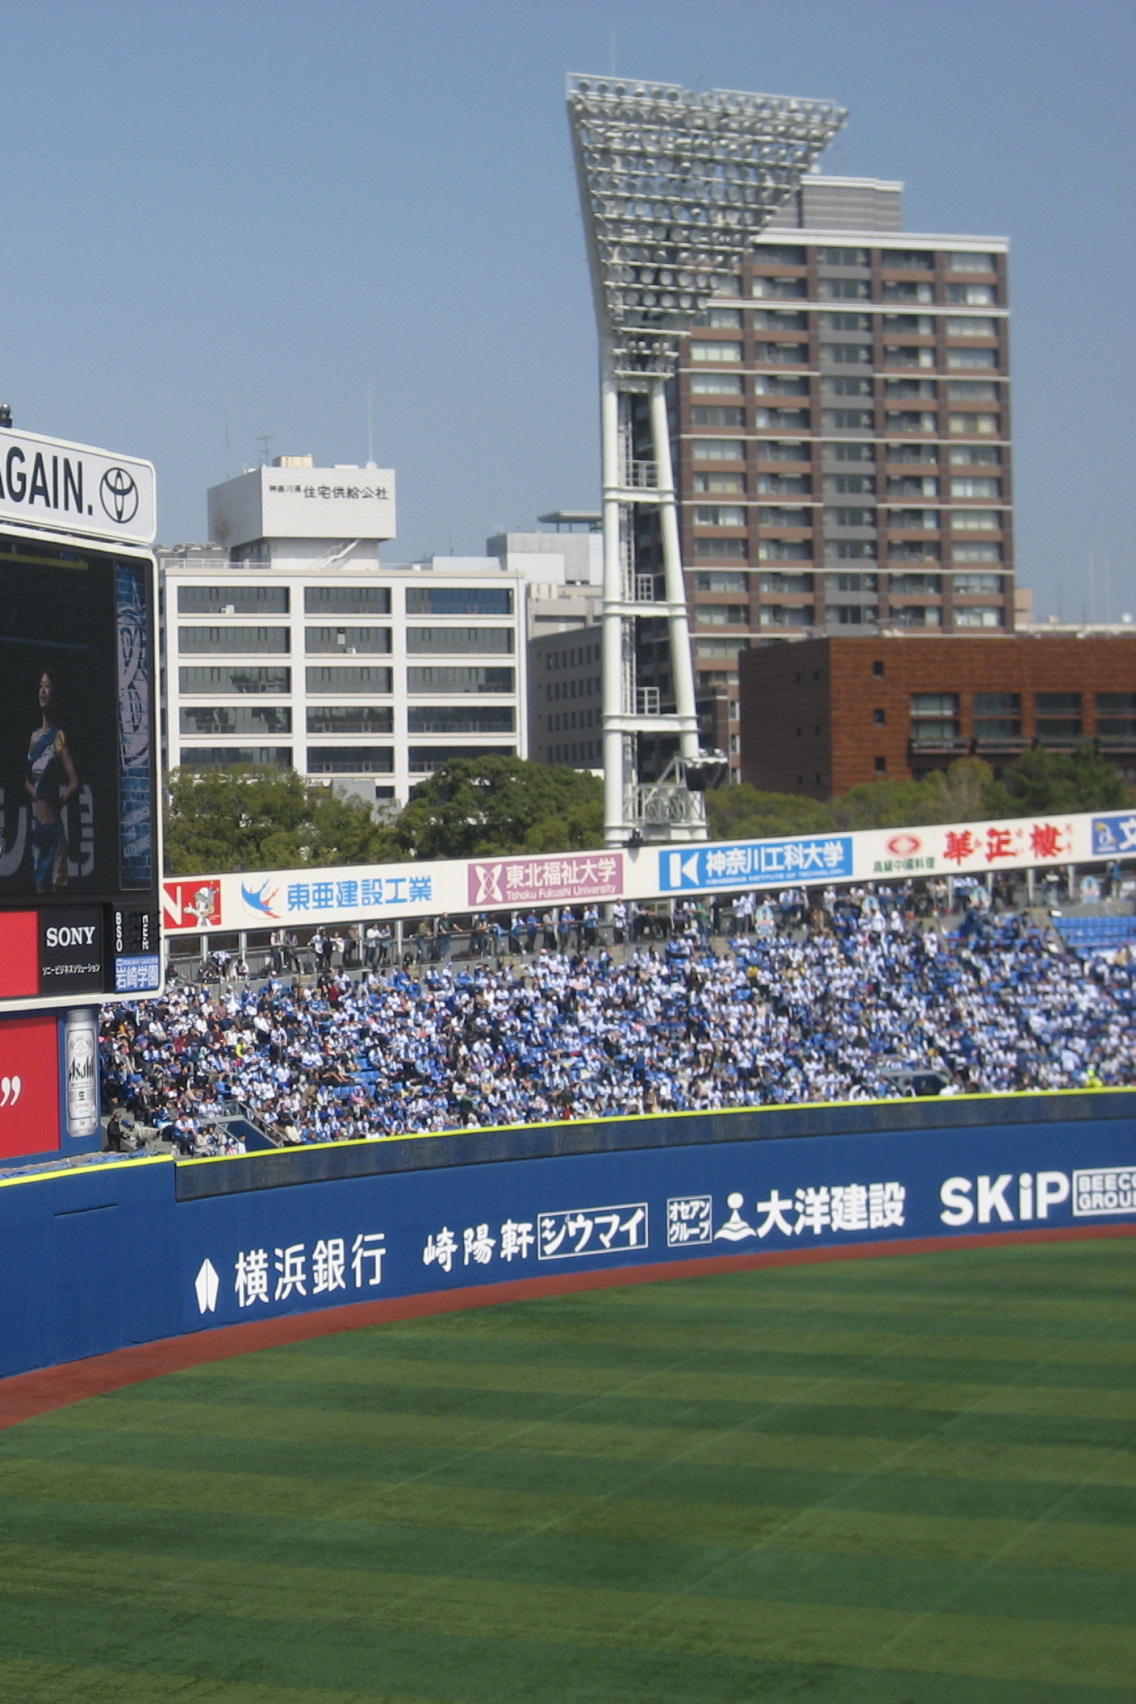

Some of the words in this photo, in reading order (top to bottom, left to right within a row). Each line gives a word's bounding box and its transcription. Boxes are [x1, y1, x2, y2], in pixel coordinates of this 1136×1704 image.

[505, 856, 617, 889] 東北福祉大学
[705, 840, 845, 878] 神奈川工科大学
[287, 875, 433, 912] 東亜建設工業
[505, 889, 537, 901] Tohoku
[538, 887, 572, 899] Fukushi
[573, 884, 617, 897] University
[46, 926, 96, 948] SONY
[41, 963, 102, 977] ソニービジネスソリューション
[116, 964, 159, 989] 岩崎学園
[69, 1055, 95, 1082] Asahi
[1079, 1174, 1136, 1192] BEEC
[669, 1200, 711, 1222] オセアン
[756, 1182, 906, 1239] 大洋建設
[939, 1170, 1071, 1227] SKiP
[422, 1218, 536, 1273] 崎陽軒
[541, 1208, 645, 1256] シウマイ
[669, 1220, 711, 1243] グループ
[234, 1233, 387, 1308] 横浜銀行
